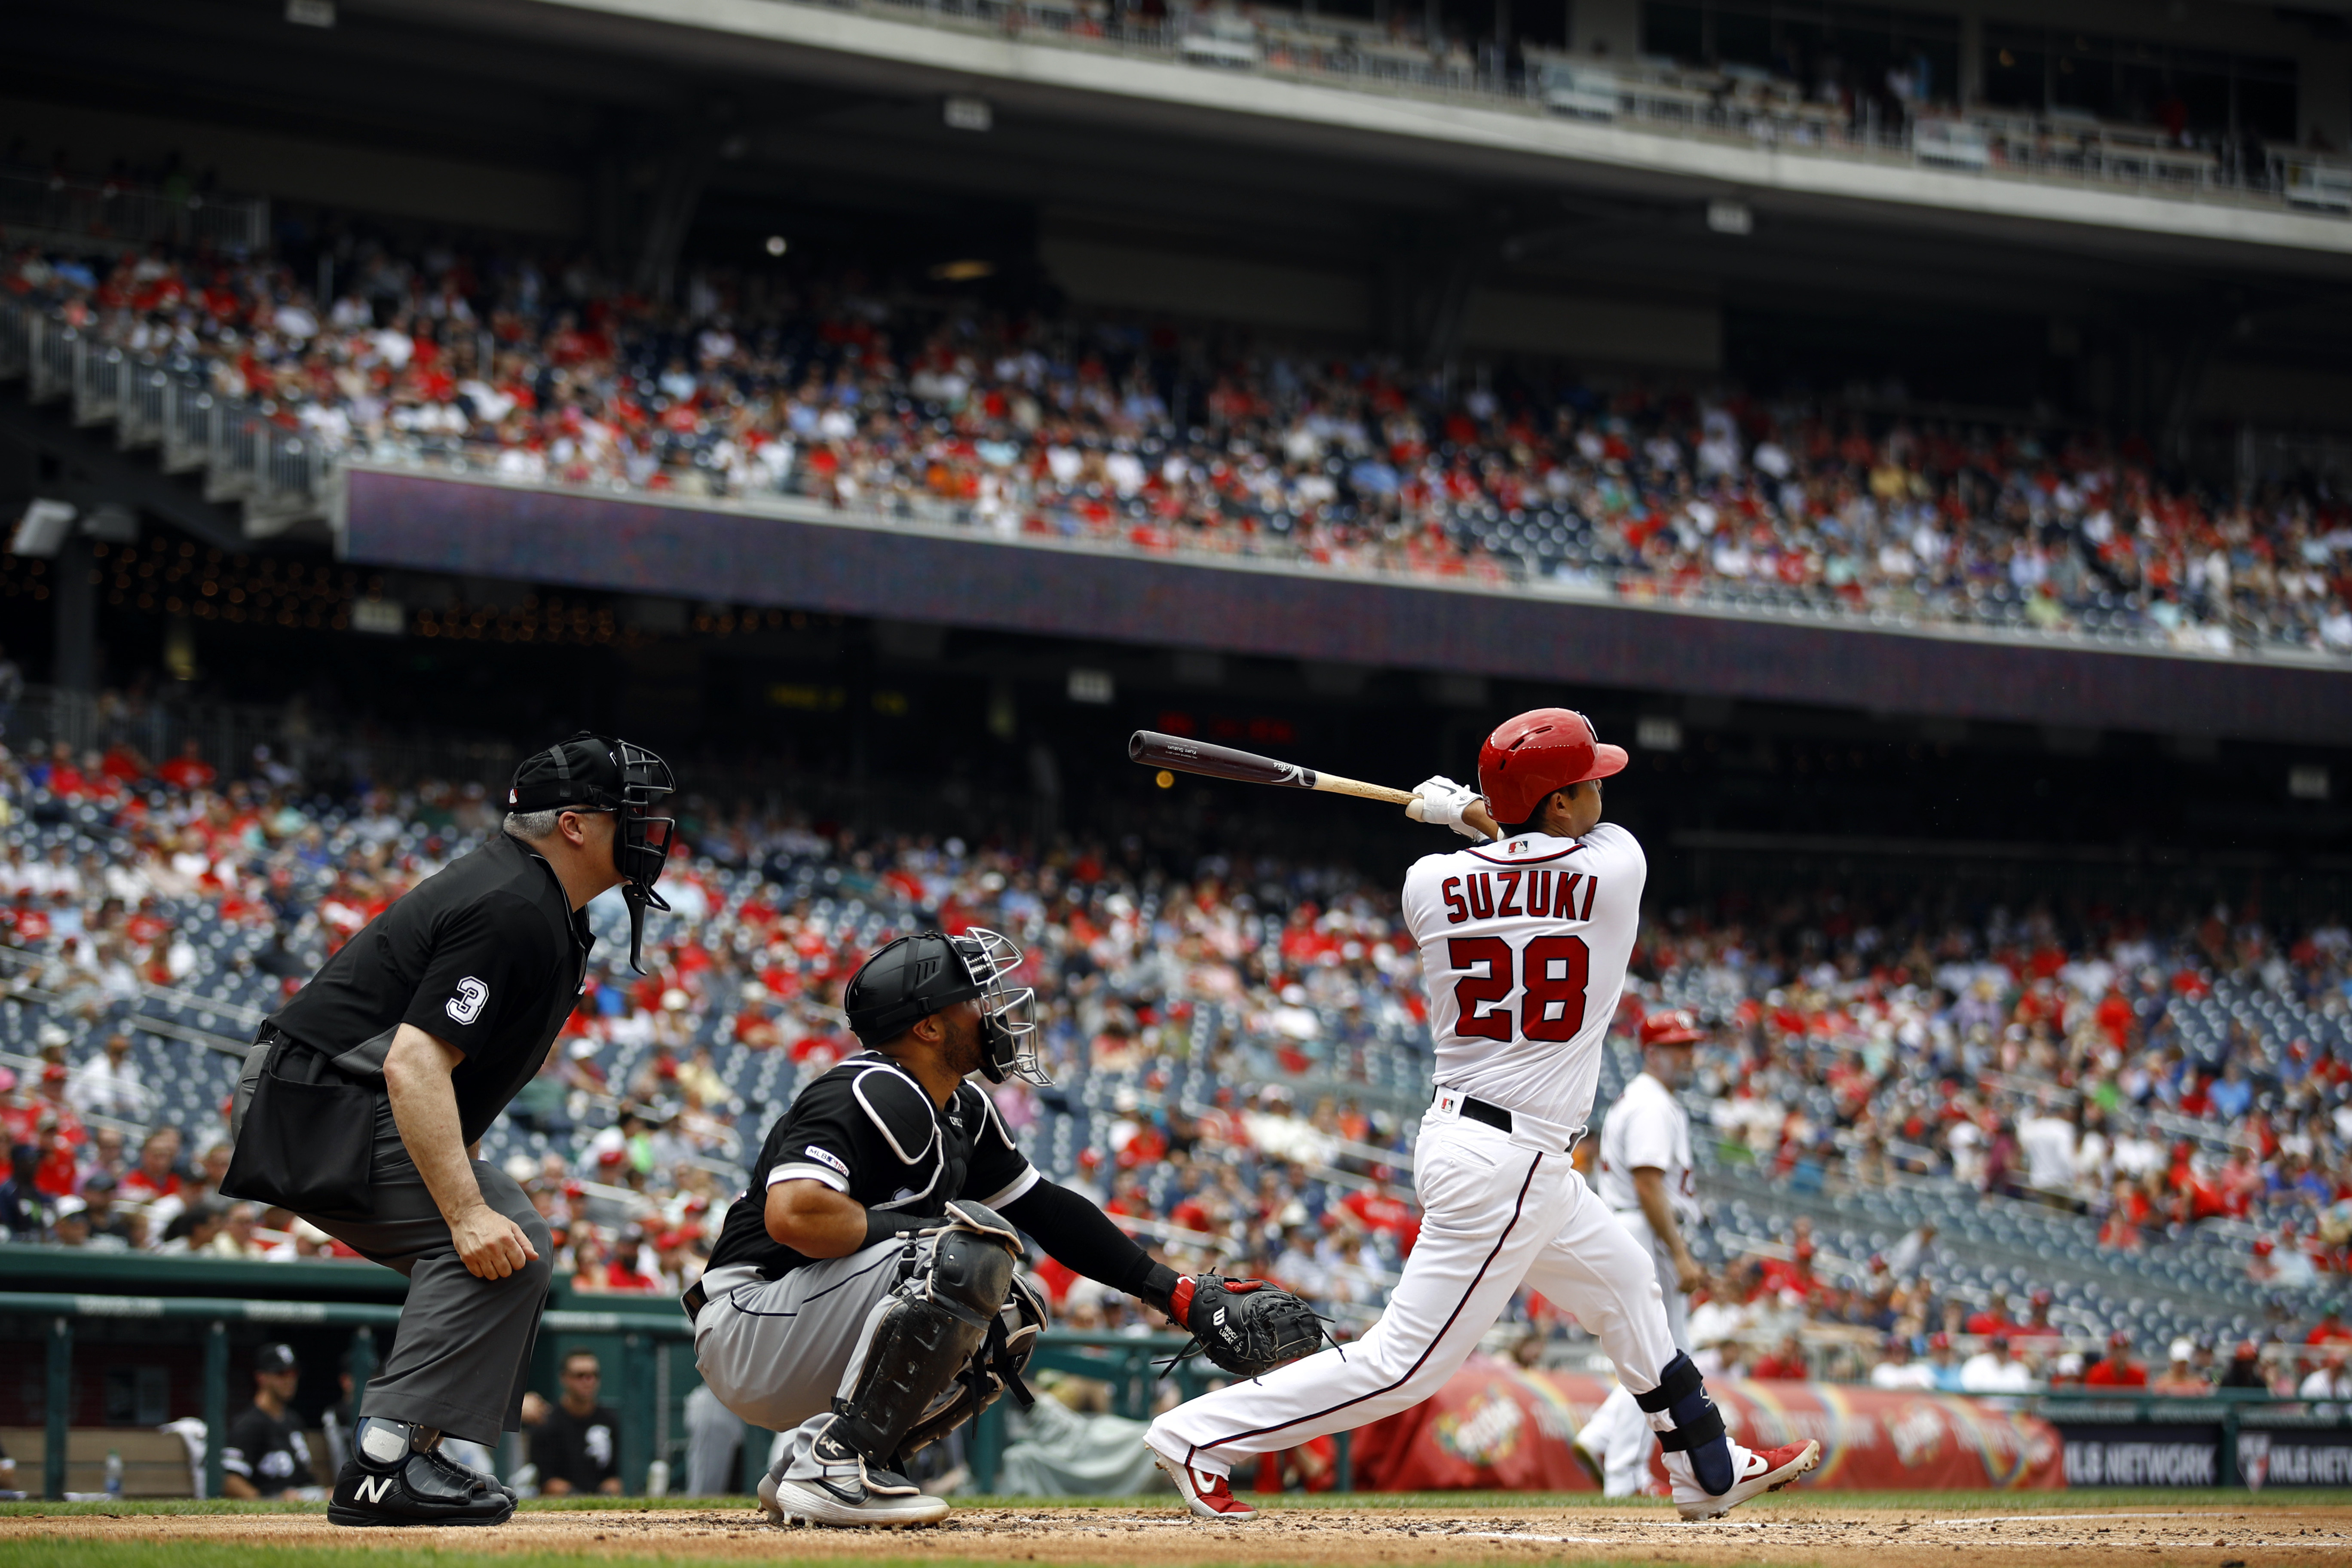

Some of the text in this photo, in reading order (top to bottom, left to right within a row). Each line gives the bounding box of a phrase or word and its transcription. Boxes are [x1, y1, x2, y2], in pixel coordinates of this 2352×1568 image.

[1271, 762, 1313, 787] Victus
[1441, 870, 1598, 924] SUZUKI
[446, 976, 489, 1025] 3
[1447, 935, 1589, 1043] 28
[809, 1148, 848, 1176] MLB 150
[2106, 1442, 2217, 1485] NETWORK
[354, 1475, 393, 1504] N
